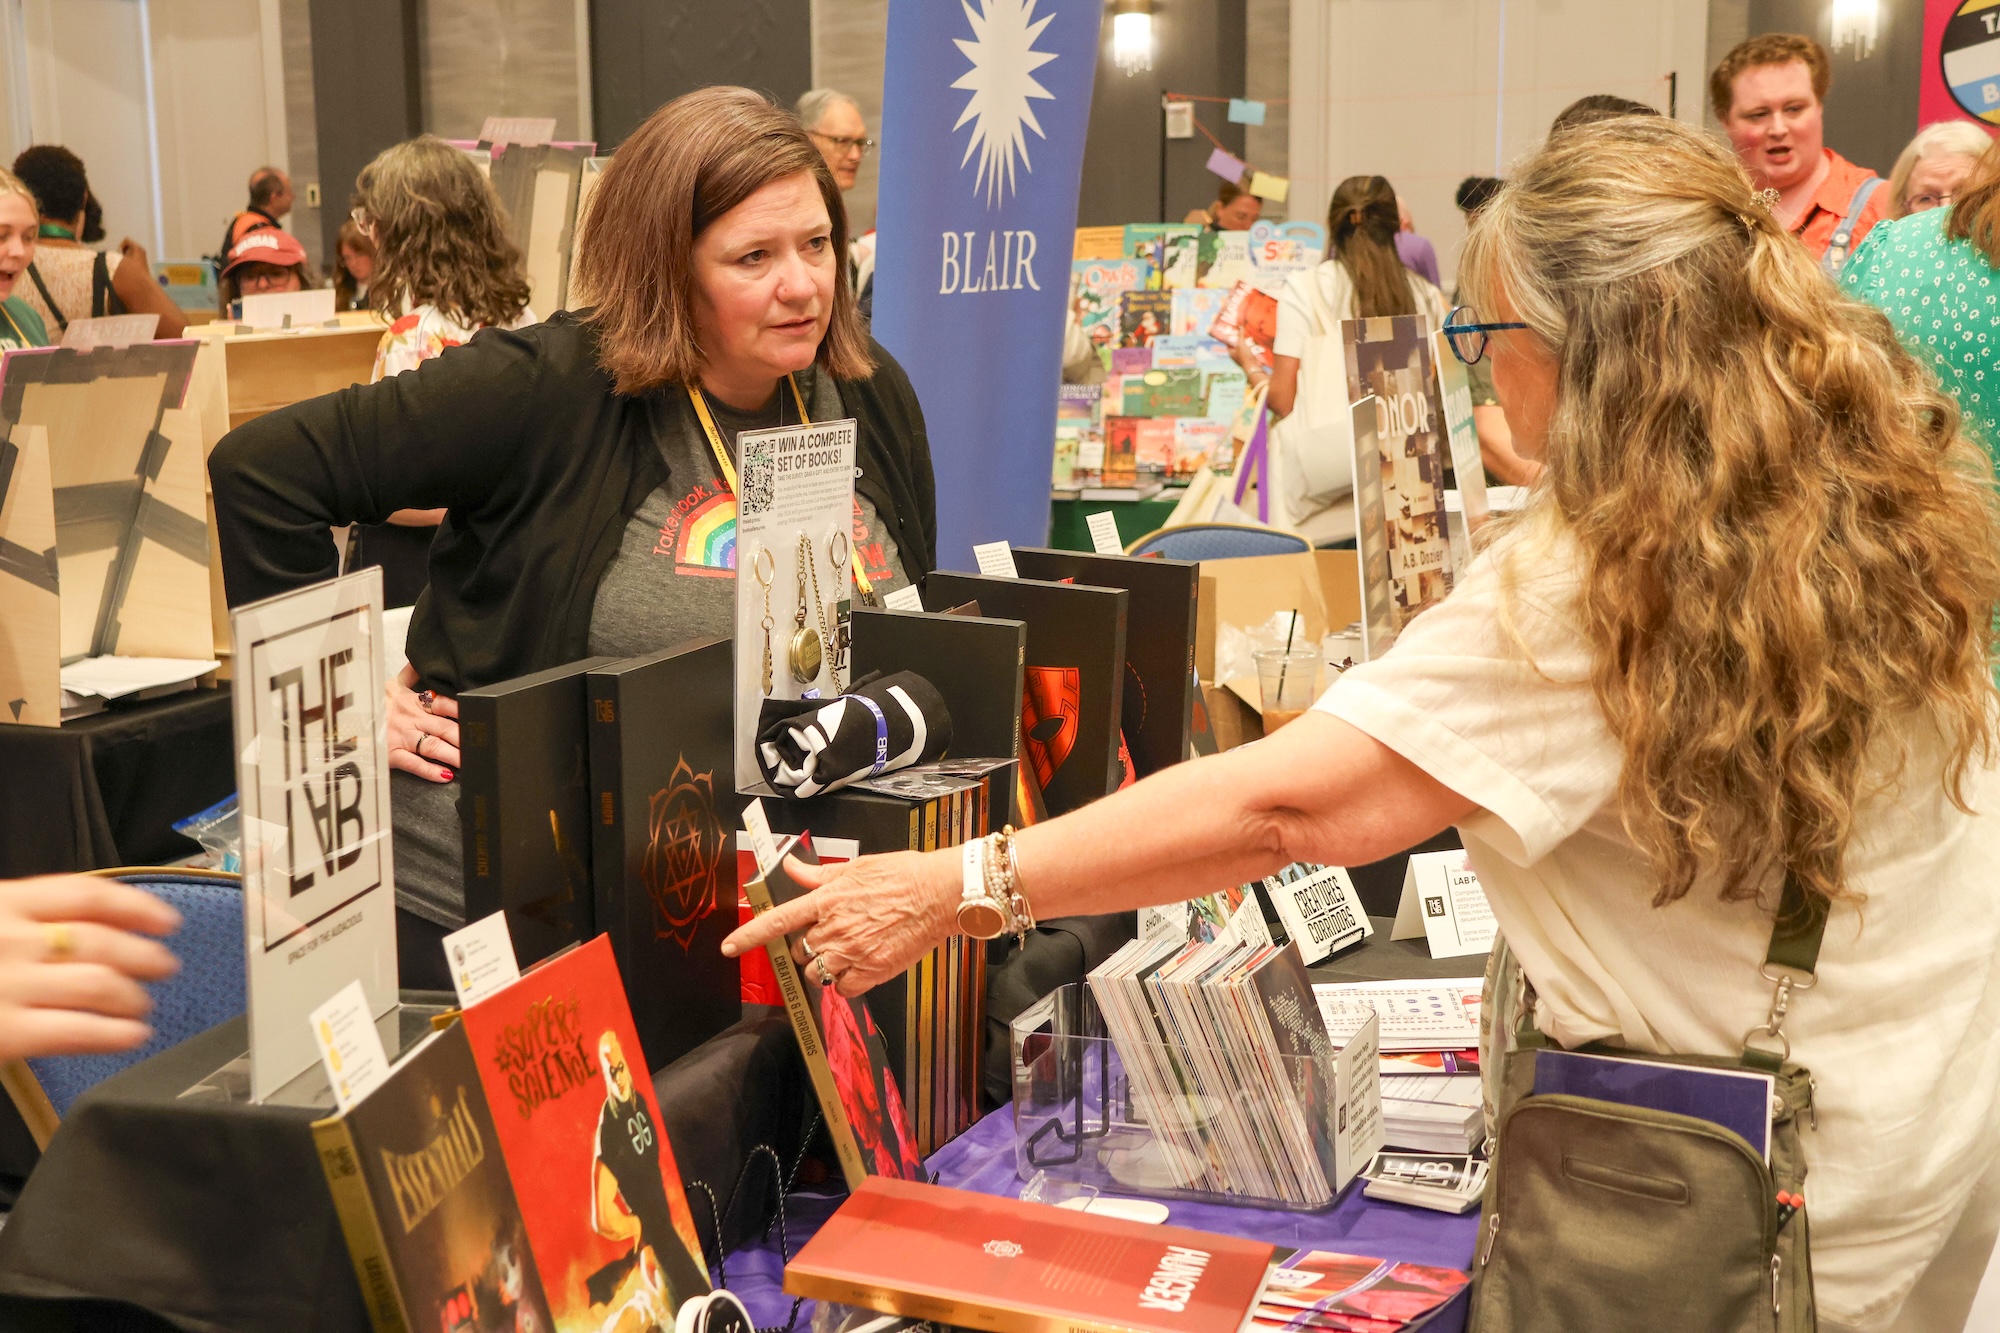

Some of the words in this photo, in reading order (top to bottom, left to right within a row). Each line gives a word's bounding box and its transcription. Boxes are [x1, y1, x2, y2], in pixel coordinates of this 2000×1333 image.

[939, 230, 1041, 294] BLAIR
[1375, 391, 1430, 440] ONOR
[777, 455, 793, 473] SET
[794, 453, 807, 470] OF
[808, 448, 842, 468] BOOKS!
[778, 436, 798, 453] WIN
[798, 435, 806, 450] A
[807, 429, 852, 449] COMPLETE
[652, 516, 679, 555] Take
[1419, 548, 1444, 567] Dozier
[269, 647, 359, 780] THE
[285, 760, 364, 898] LAB
[1293, 875, 1345, 919] CREATURES
[1453, 876, 1470, 885] LAB
[1471, 876, 1477, 884] P
[1307, 905, 1356, 944] CORRIDORS
[774, 955, 798, 1003] CREATURES
[793, 1010, 818, 1057] CORRIDORS
[504, 995, 576, 1072] SUPER
[508, 1033, 598, 1120] SCIENCE
[1138, 1245, 1212, 1312] HUNGER
